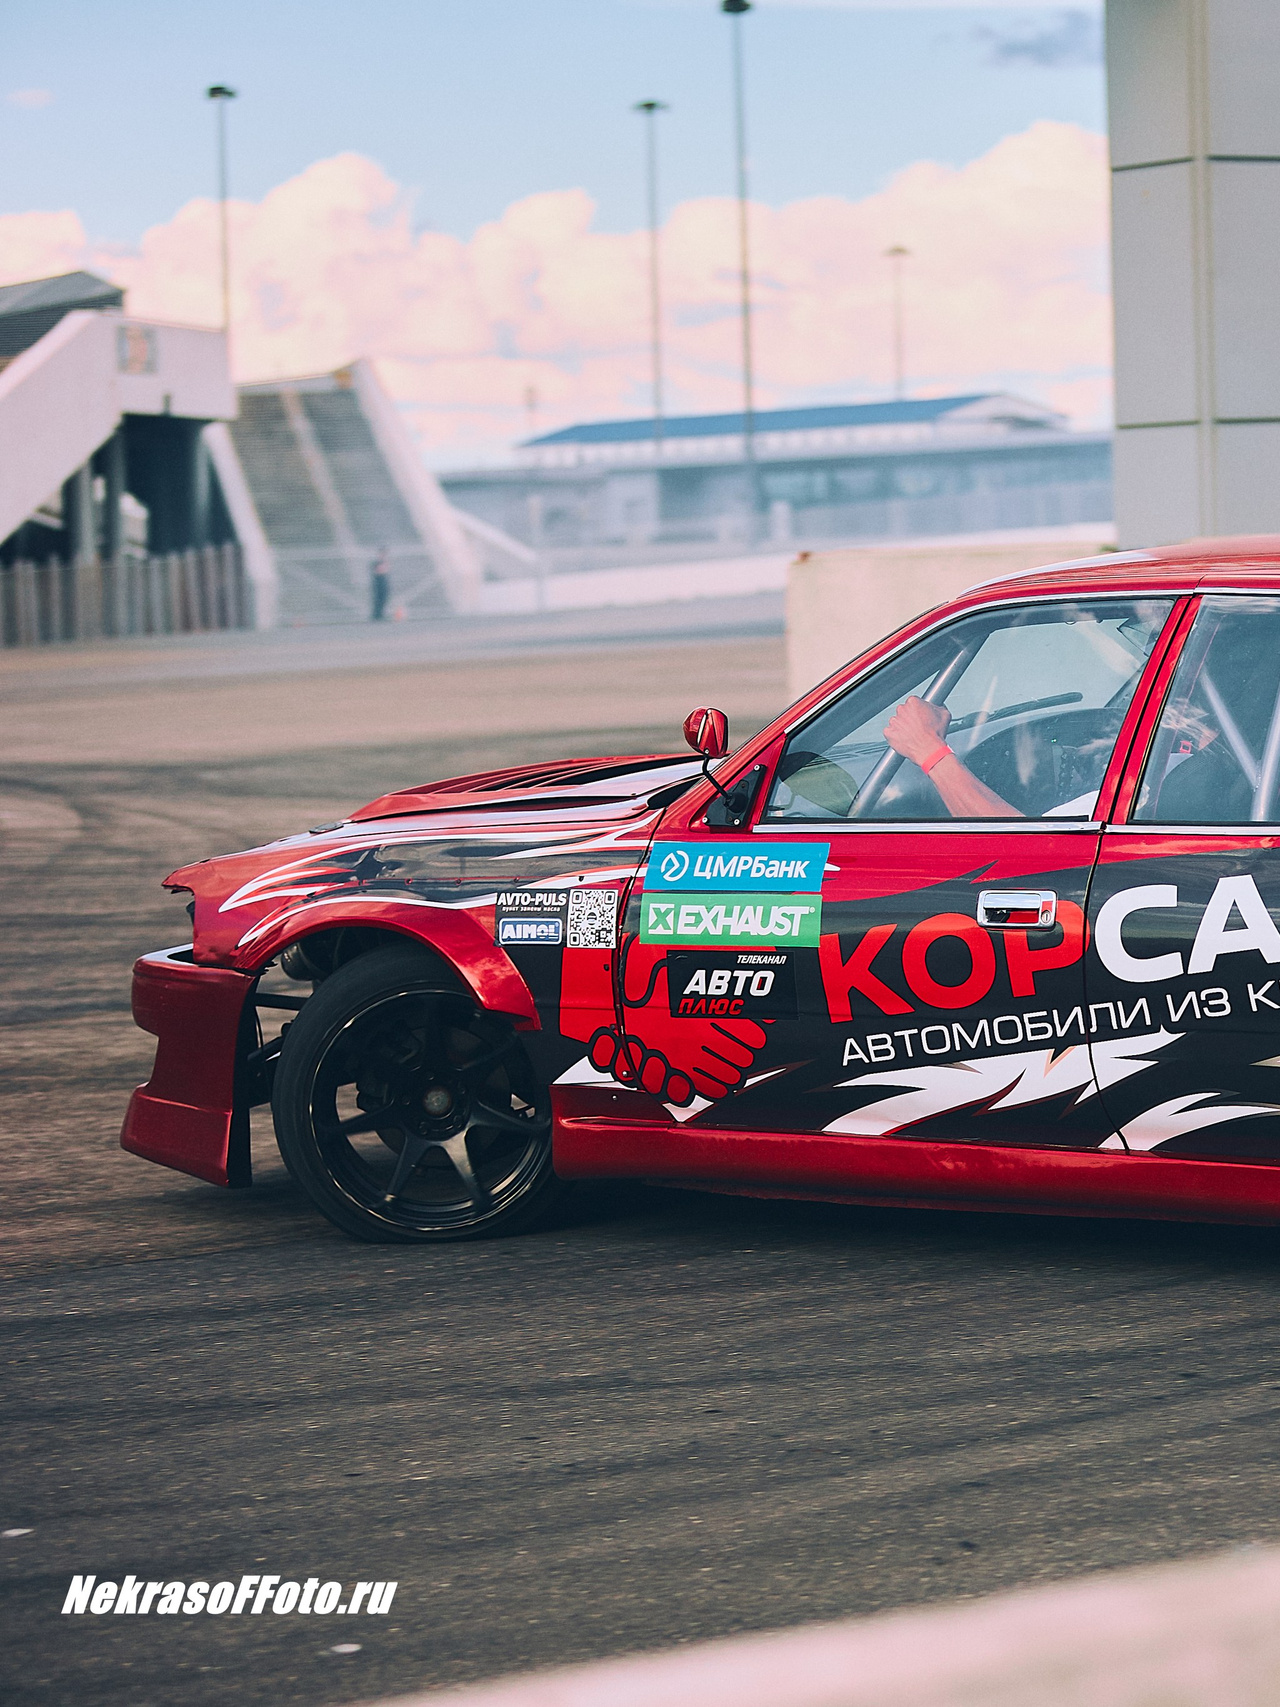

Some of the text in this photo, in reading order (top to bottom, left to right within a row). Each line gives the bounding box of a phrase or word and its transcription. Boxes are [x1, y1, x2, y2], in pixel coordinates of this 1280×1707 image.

[693, 855, 810, 880] ЦМРБанк
[497, 892, 567, 906] AVTO-PULS
[677, 905, 810, 936] EXHAUST
[502, 924, 560, 939] AIMOL
[736, 955, 787, 965] ТЕЛЕКАНАЛ
[683, 970, 775, 996] АВТО
[678, 998, 744, 1015] ПЛЮС
[841, 998, 1151, 1066] АВТОМОБИЛИ
[1166, 986, 1231, 1023] ИЗ
